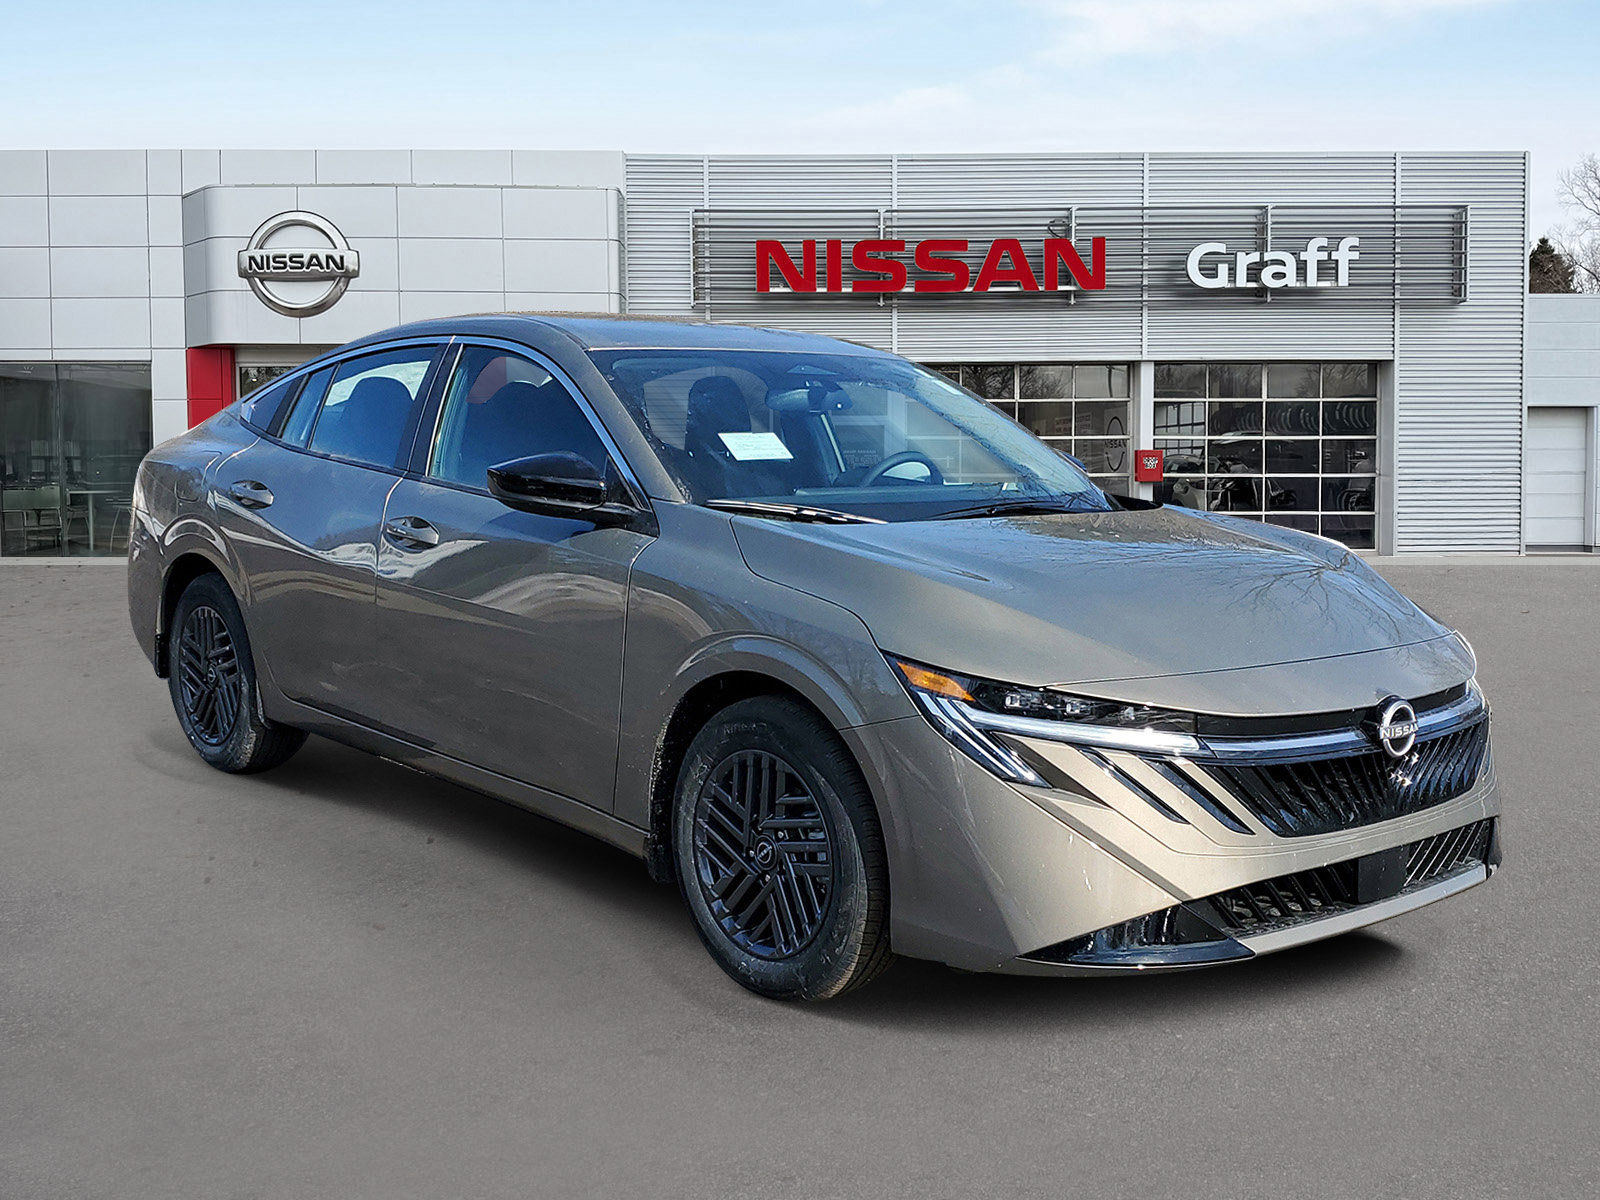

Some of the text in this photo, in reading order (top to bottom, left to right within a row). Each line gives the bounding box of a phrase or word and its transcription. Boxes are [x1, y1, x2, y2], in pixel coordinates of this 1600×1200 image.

[248, 254, 344, 271] NISSAN
[755, 237, 1360, 292] NISSAN Graff
[1380, 722, 1419, 739] NISSAN
